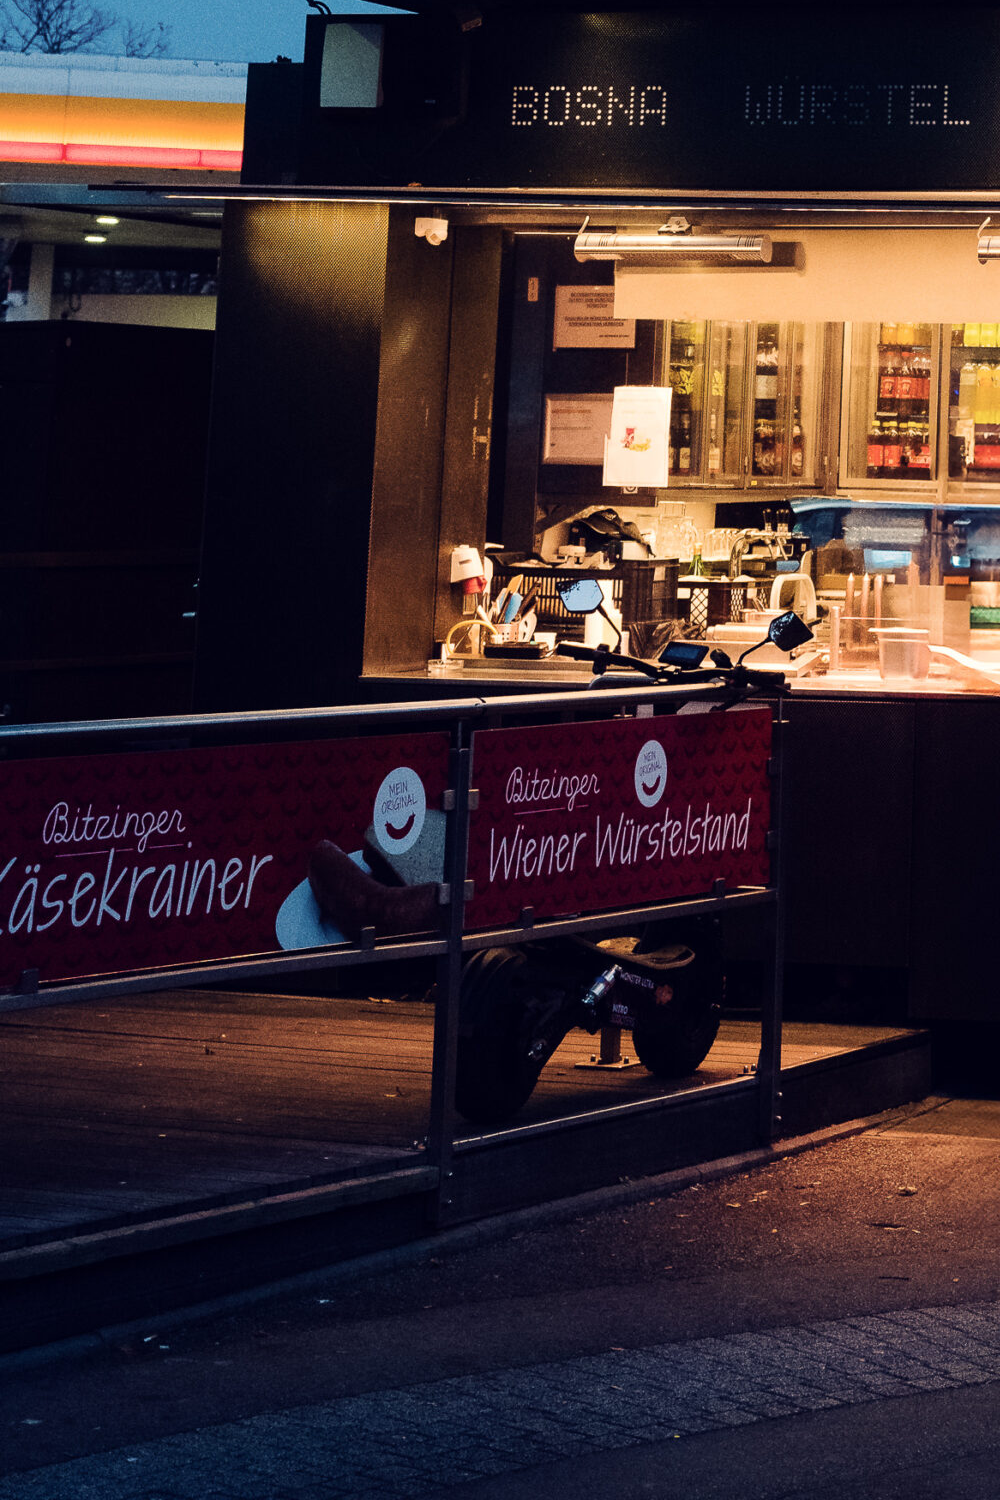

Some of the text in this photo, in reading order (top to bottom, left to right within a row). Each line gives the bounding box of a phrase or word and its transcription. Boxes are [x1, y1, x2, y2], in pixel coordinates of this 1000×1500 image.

[512, 85, 668, 126] BOSNA
[744, 75, 971, 126] WÜRSTEL
[381, 793, 418, 815] ORIGINAL
[388, 781, 408, 797] MEIN
[505, 766, 600, 812] Bitzinger
[43, 801, 186, 853] Bitzinger
[489, 797, 752, 882] Wiener Würstelstand
[0, 841, 274, 937] äsekrainer
